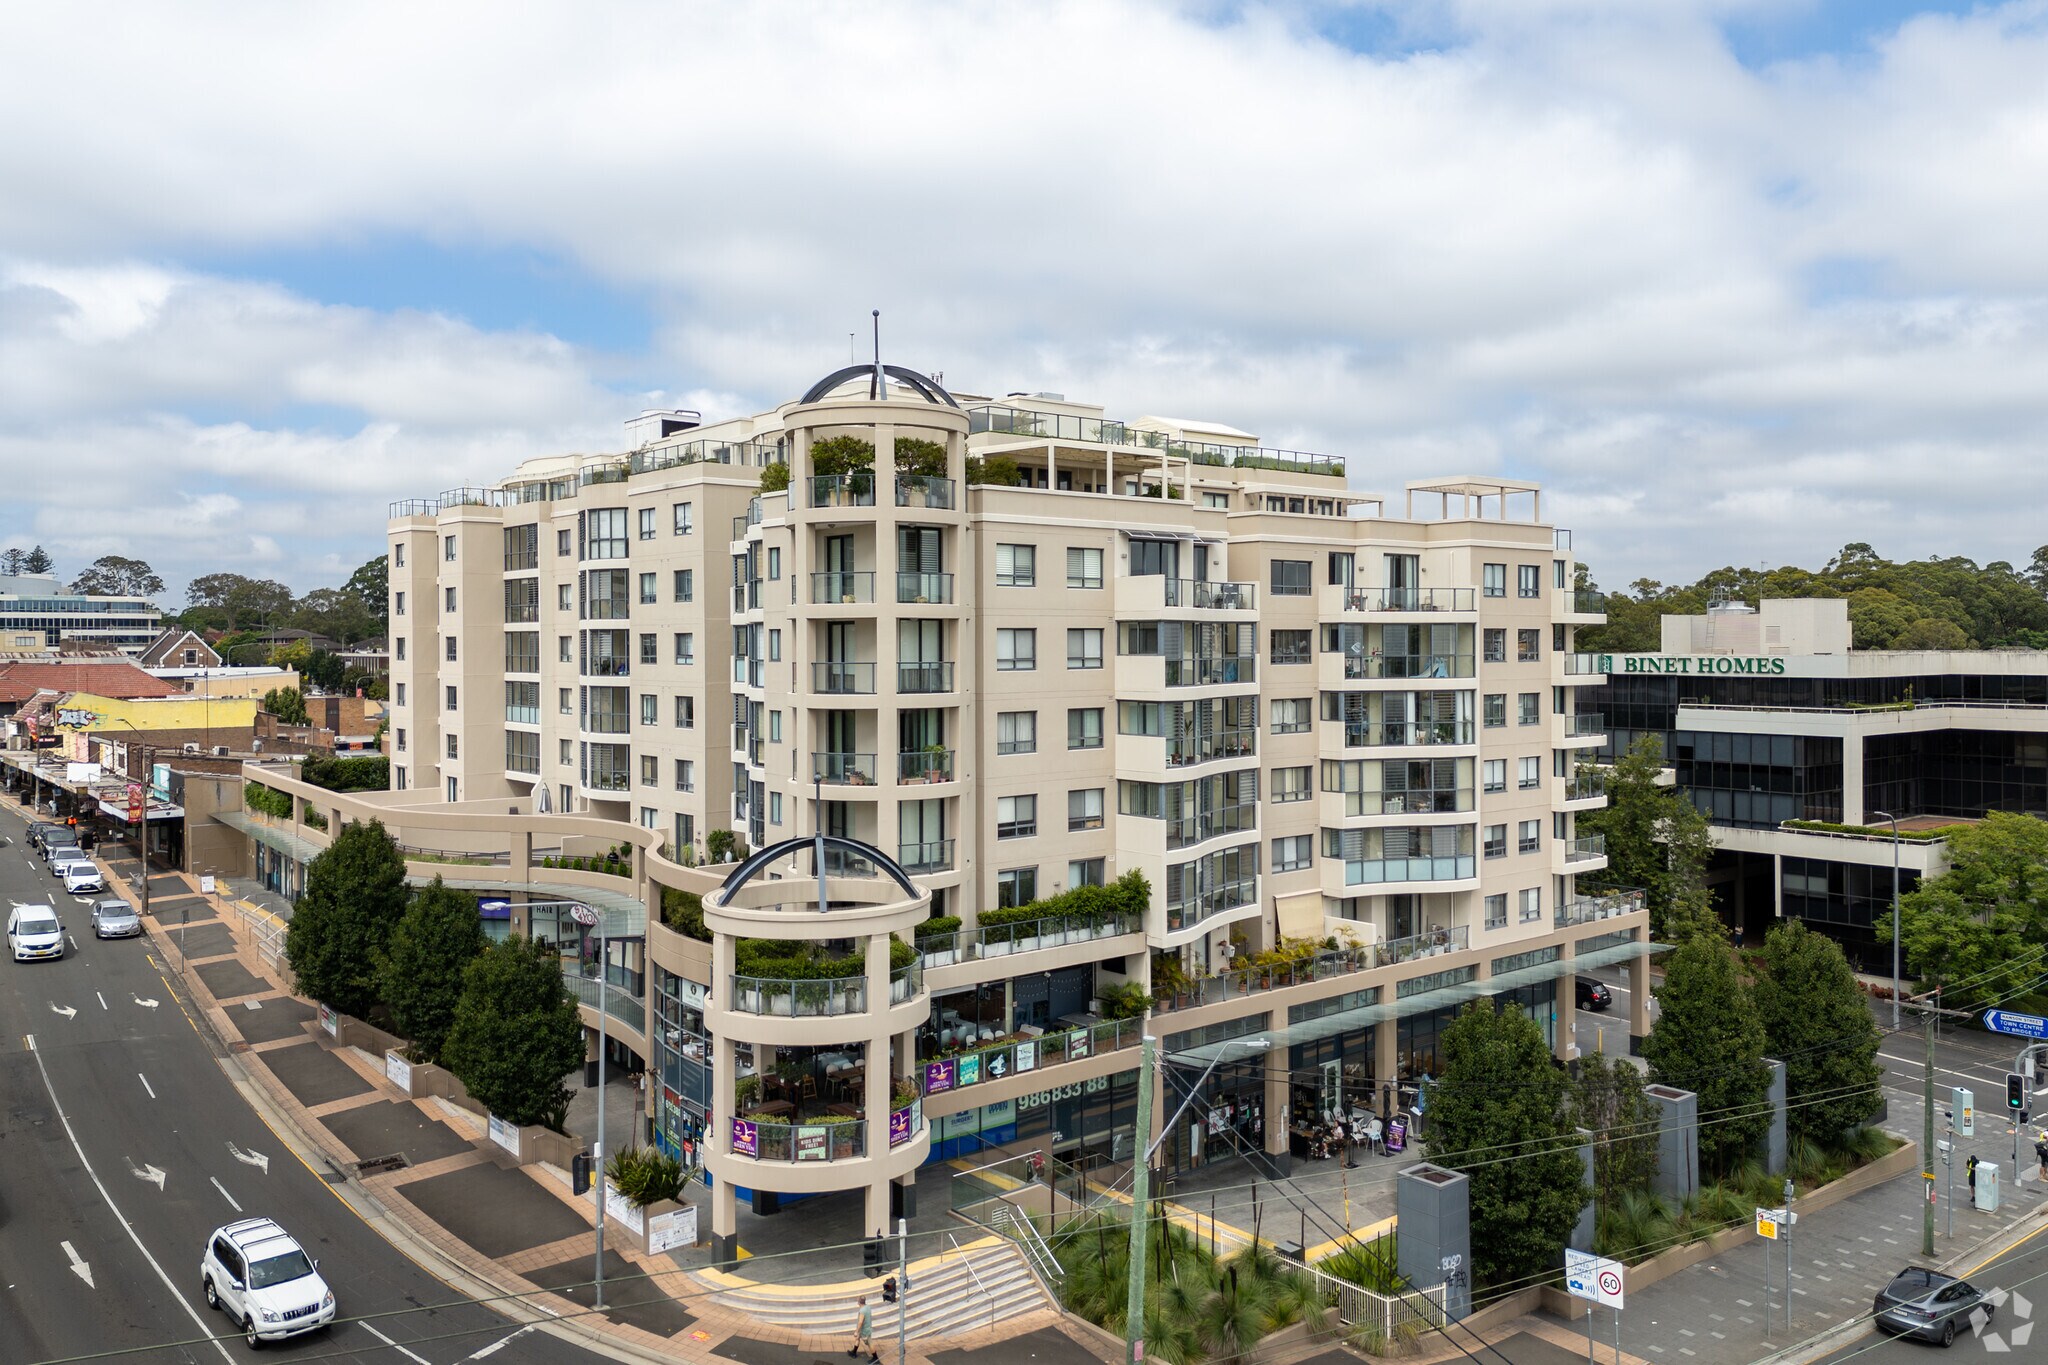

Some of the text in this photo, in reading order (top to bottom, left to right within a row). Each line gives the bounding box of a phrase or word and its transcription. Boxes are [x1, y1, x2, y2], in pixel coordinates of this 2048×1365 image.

[1624, 657, 1785, 674] BINET HOMES
[536, 905, 553, 914] HAIR
[2019, 1023, 2044, 1032] CENTRE
[951, 1114, 974, 1126] SURGERY
[1603, 1278, 1617, 1290] 60
